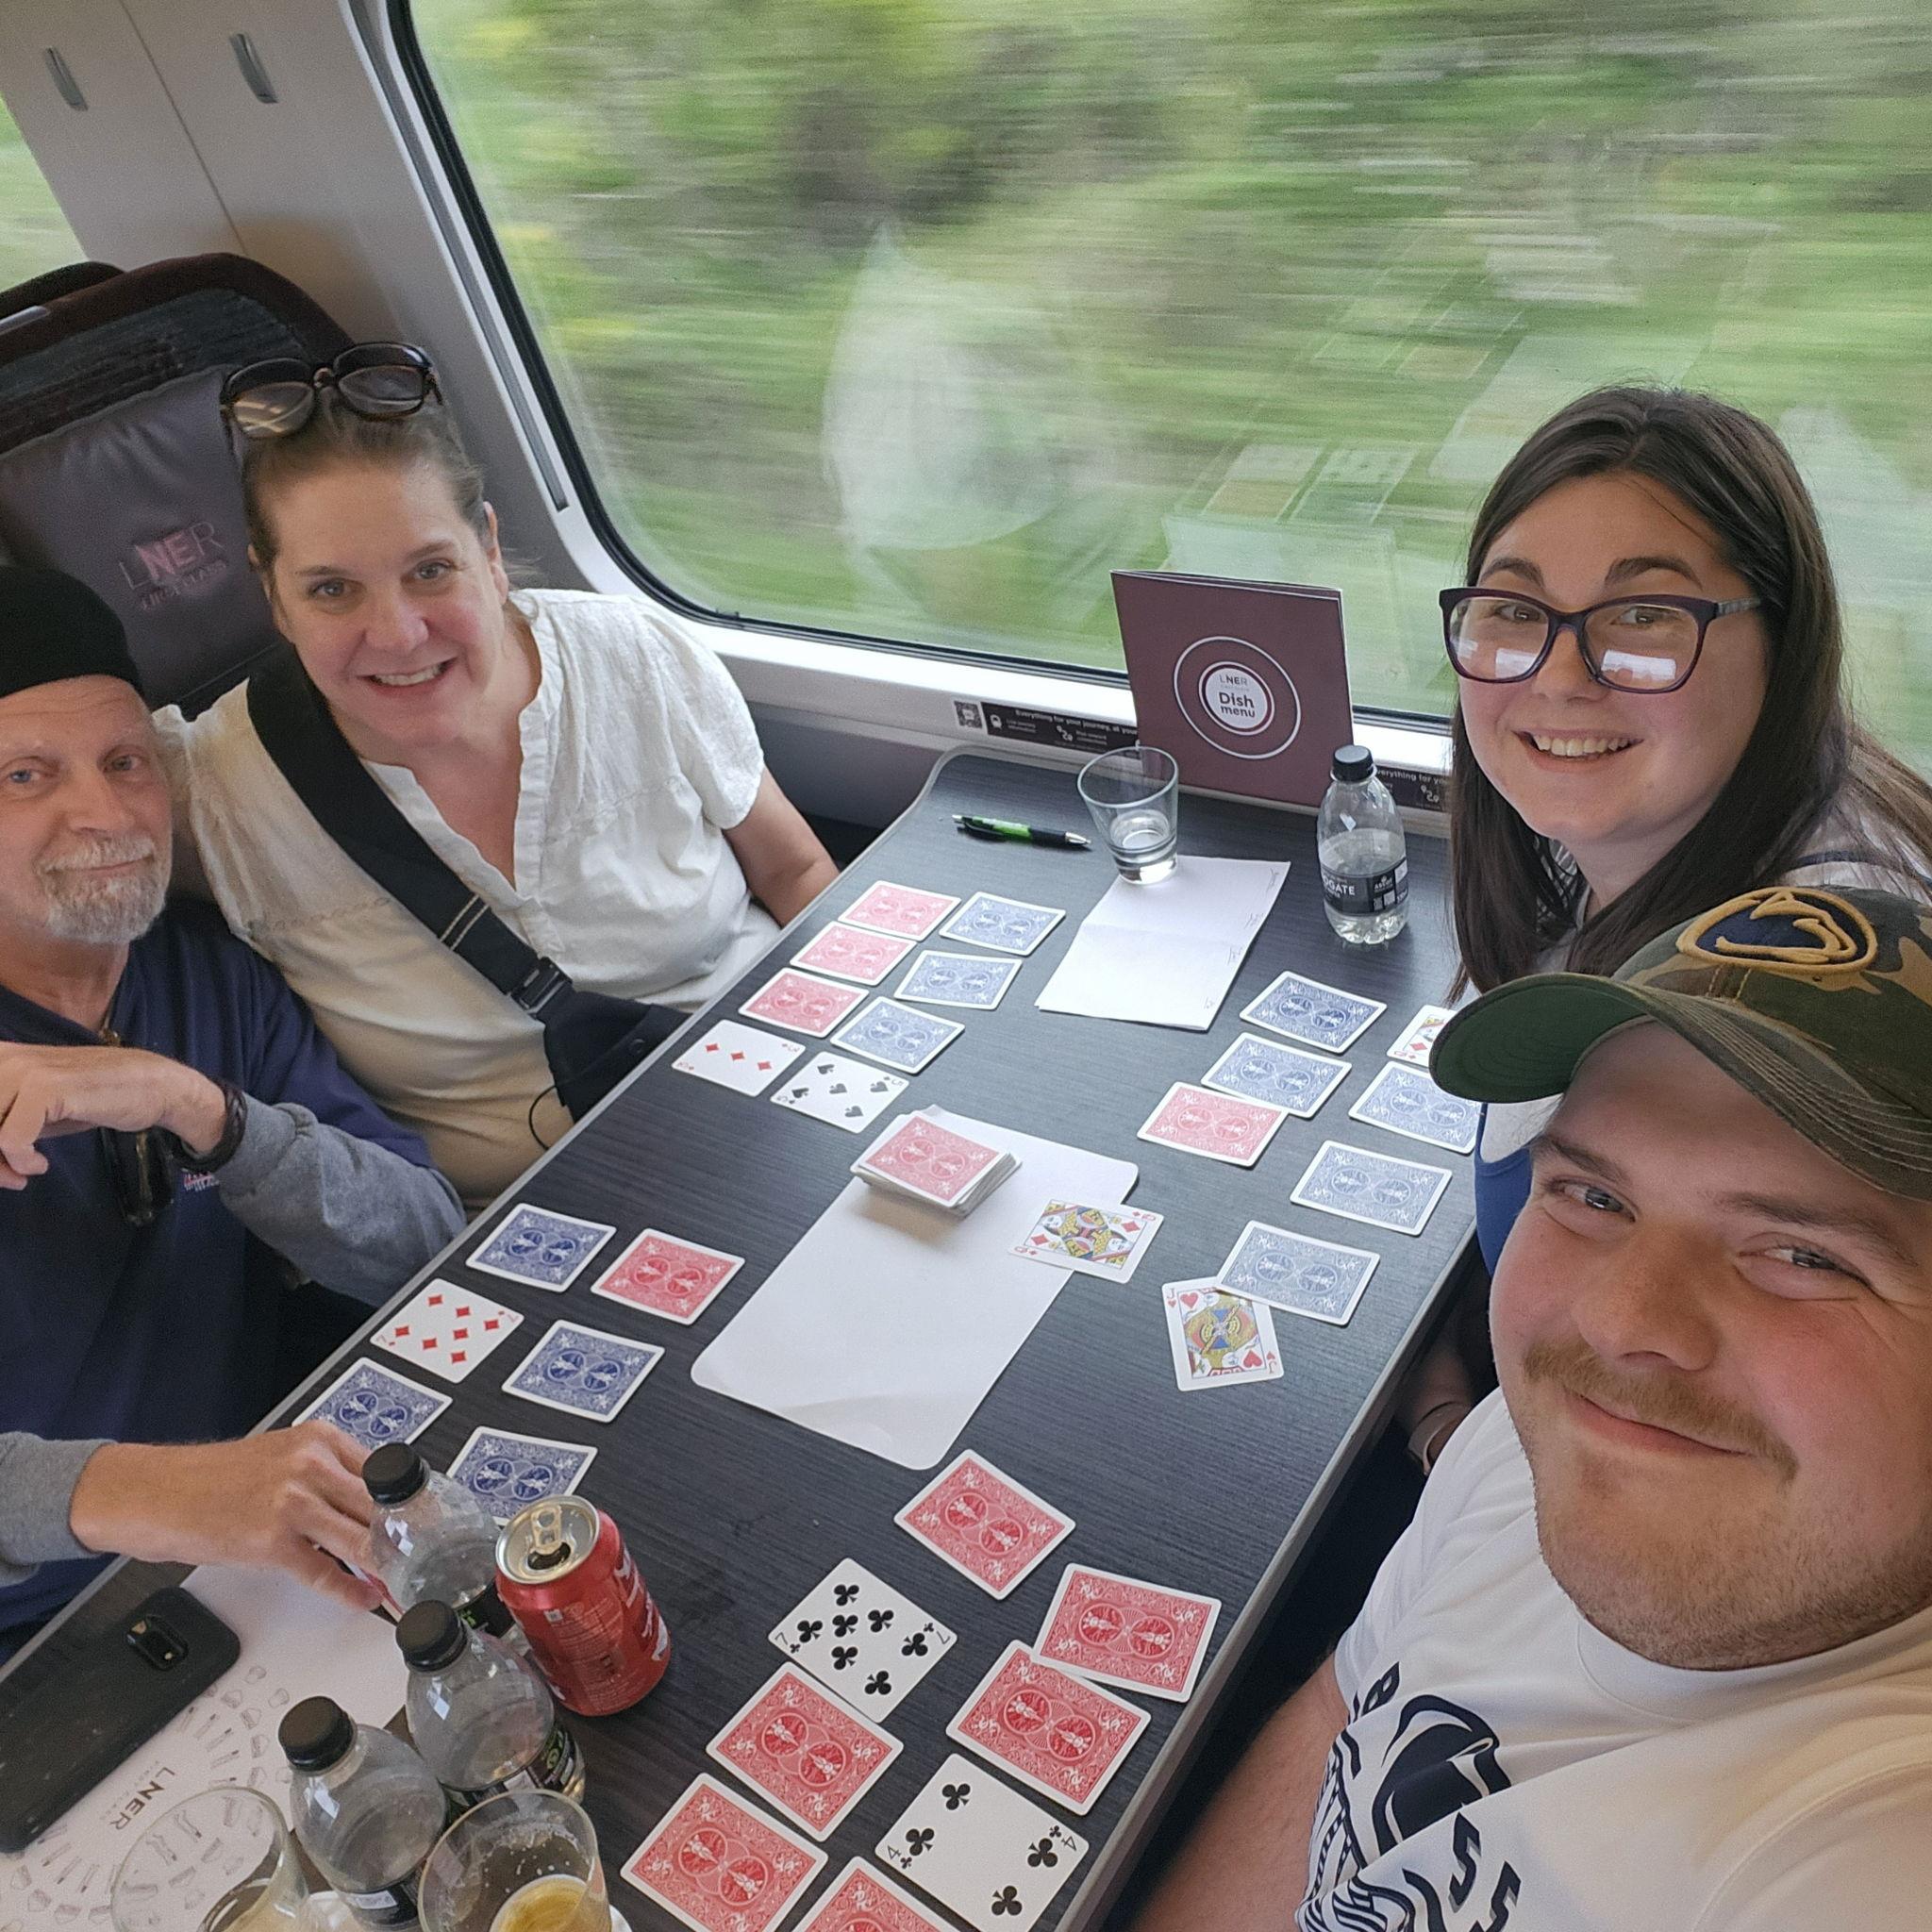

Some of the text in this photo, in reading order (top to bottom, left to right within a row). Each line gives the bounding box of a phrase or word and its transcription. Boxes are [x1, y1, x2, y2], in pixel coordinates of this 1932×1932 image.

[118, 522, 226, 590] LNER
[1219, 674, 1248, 686] LNER
[1219, 691, 1255, 708] Dish
[1220, 706, 1256, 718] menu
[1377, 769, 1416, 782] verything
[1166, 1288, 1175, 1299] J
[774, 1631, 789, 1646] 7
[936, 1630, 951, 1645] 7
[108, 1766, 175, 1830] LNER
[1060, 1835, 1077, 1852] 4
[887, 1844, 902, 1860] 4
